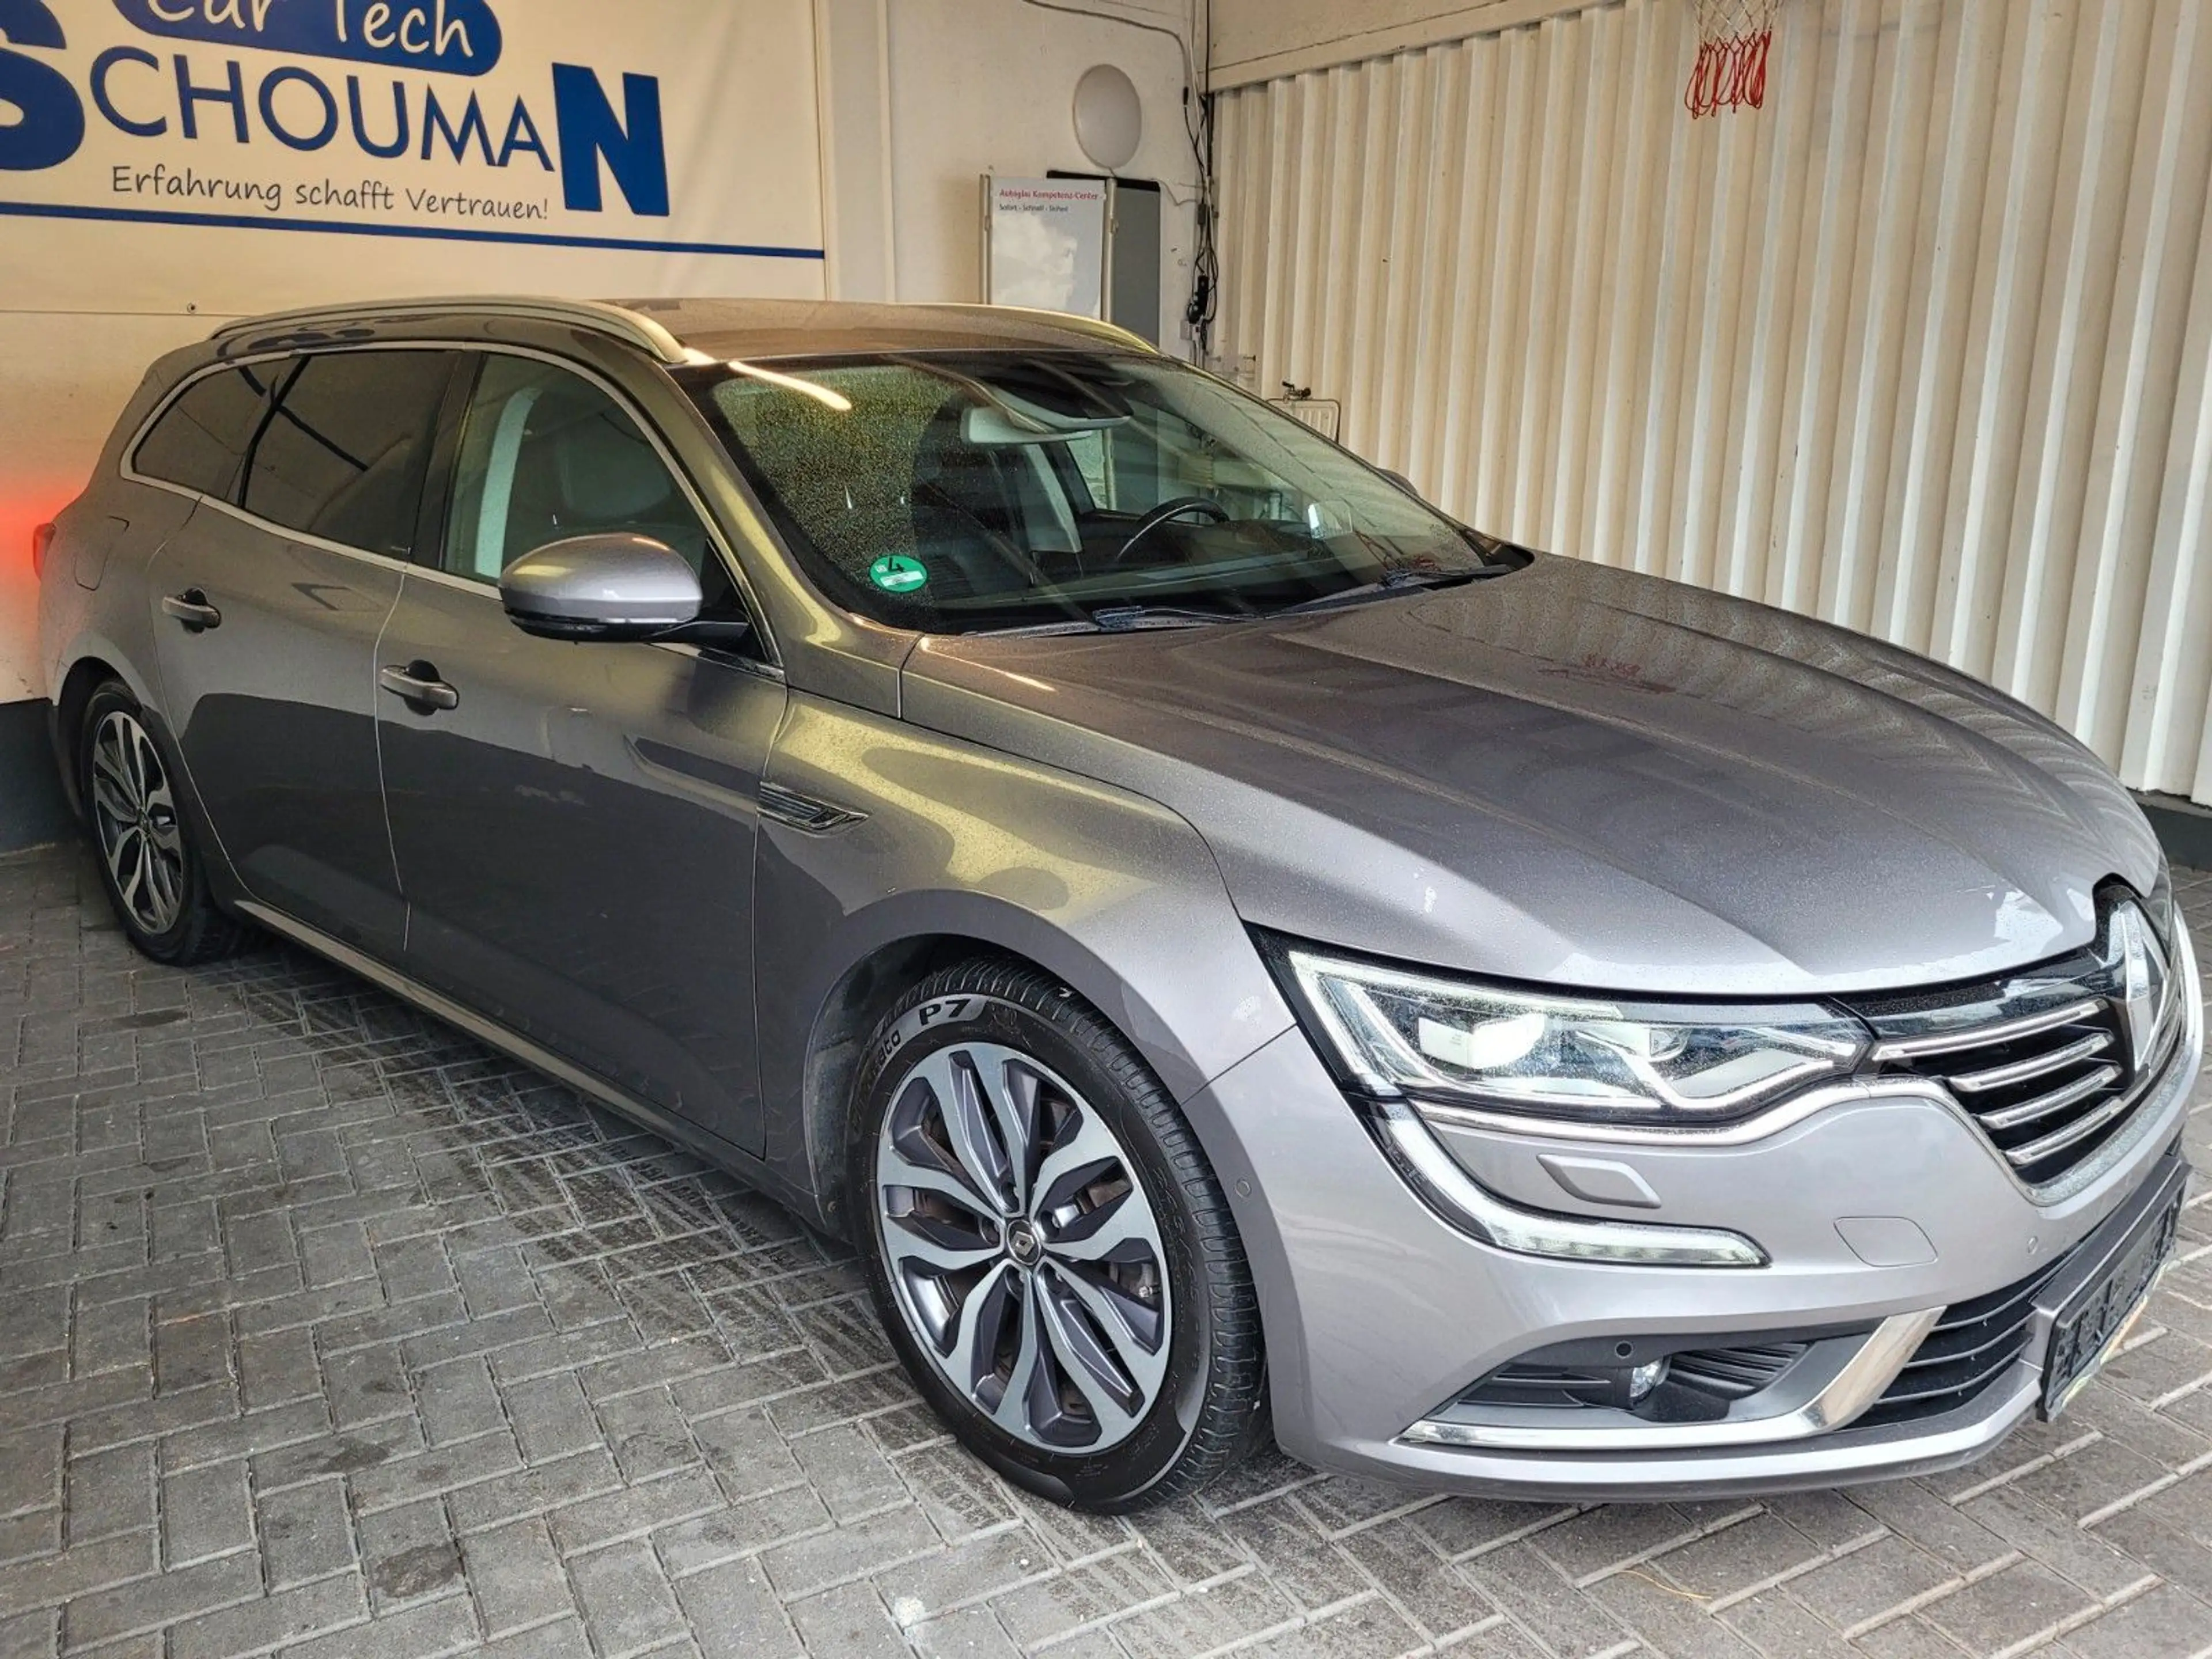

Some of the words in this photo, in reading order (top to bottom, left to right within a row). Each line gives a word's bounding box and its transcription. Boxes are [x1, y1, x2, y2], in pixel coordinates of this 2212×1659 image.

[112, 164, 282, 211] Erfahrung
[295, 179, 395, 210] schafft
[406, 188, 548, 220] Vertrauen!
[888, 557, 904, 573] 4
[919, 998, 972, 1027] P7
